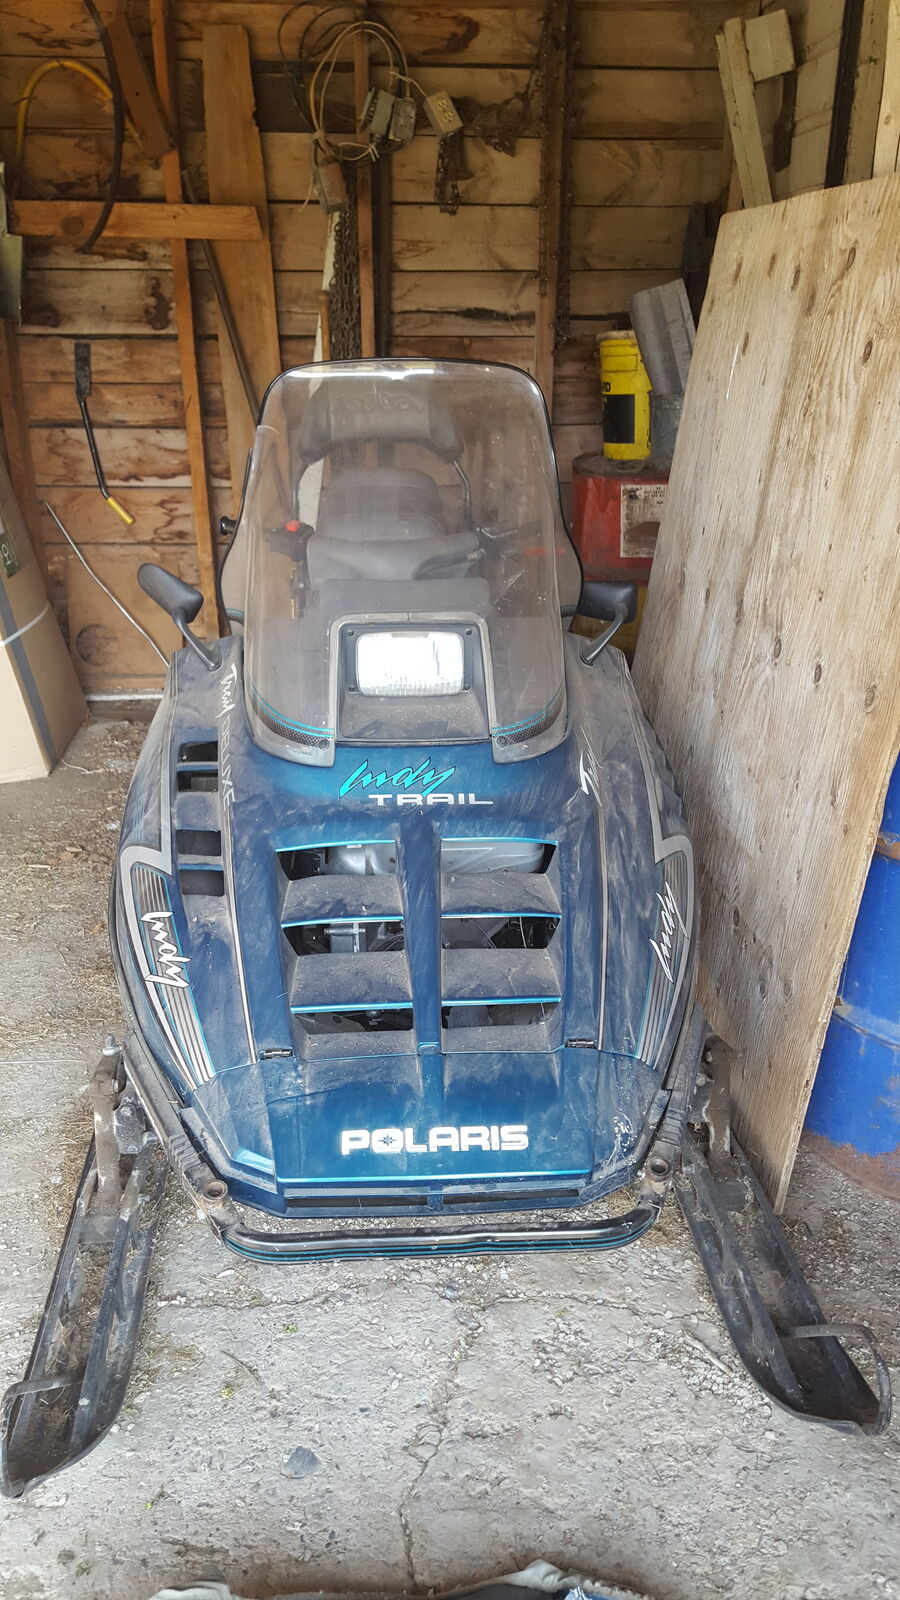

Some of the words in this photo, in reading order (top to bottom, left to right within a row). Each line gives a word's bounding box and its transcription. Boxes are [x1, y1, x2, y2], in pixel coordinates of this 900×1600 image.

[215, 663, 238, 719] Trail
[220, 716, 236, 811] DELUXE
[338, 757, 457, 798] Indy
[368, 793, 494, 806] TRAIL
[140, 911, 192, 988] Indy
[648, 881, 690, 984] Indy
[341, 1124, 529, 1156] POLARIS
